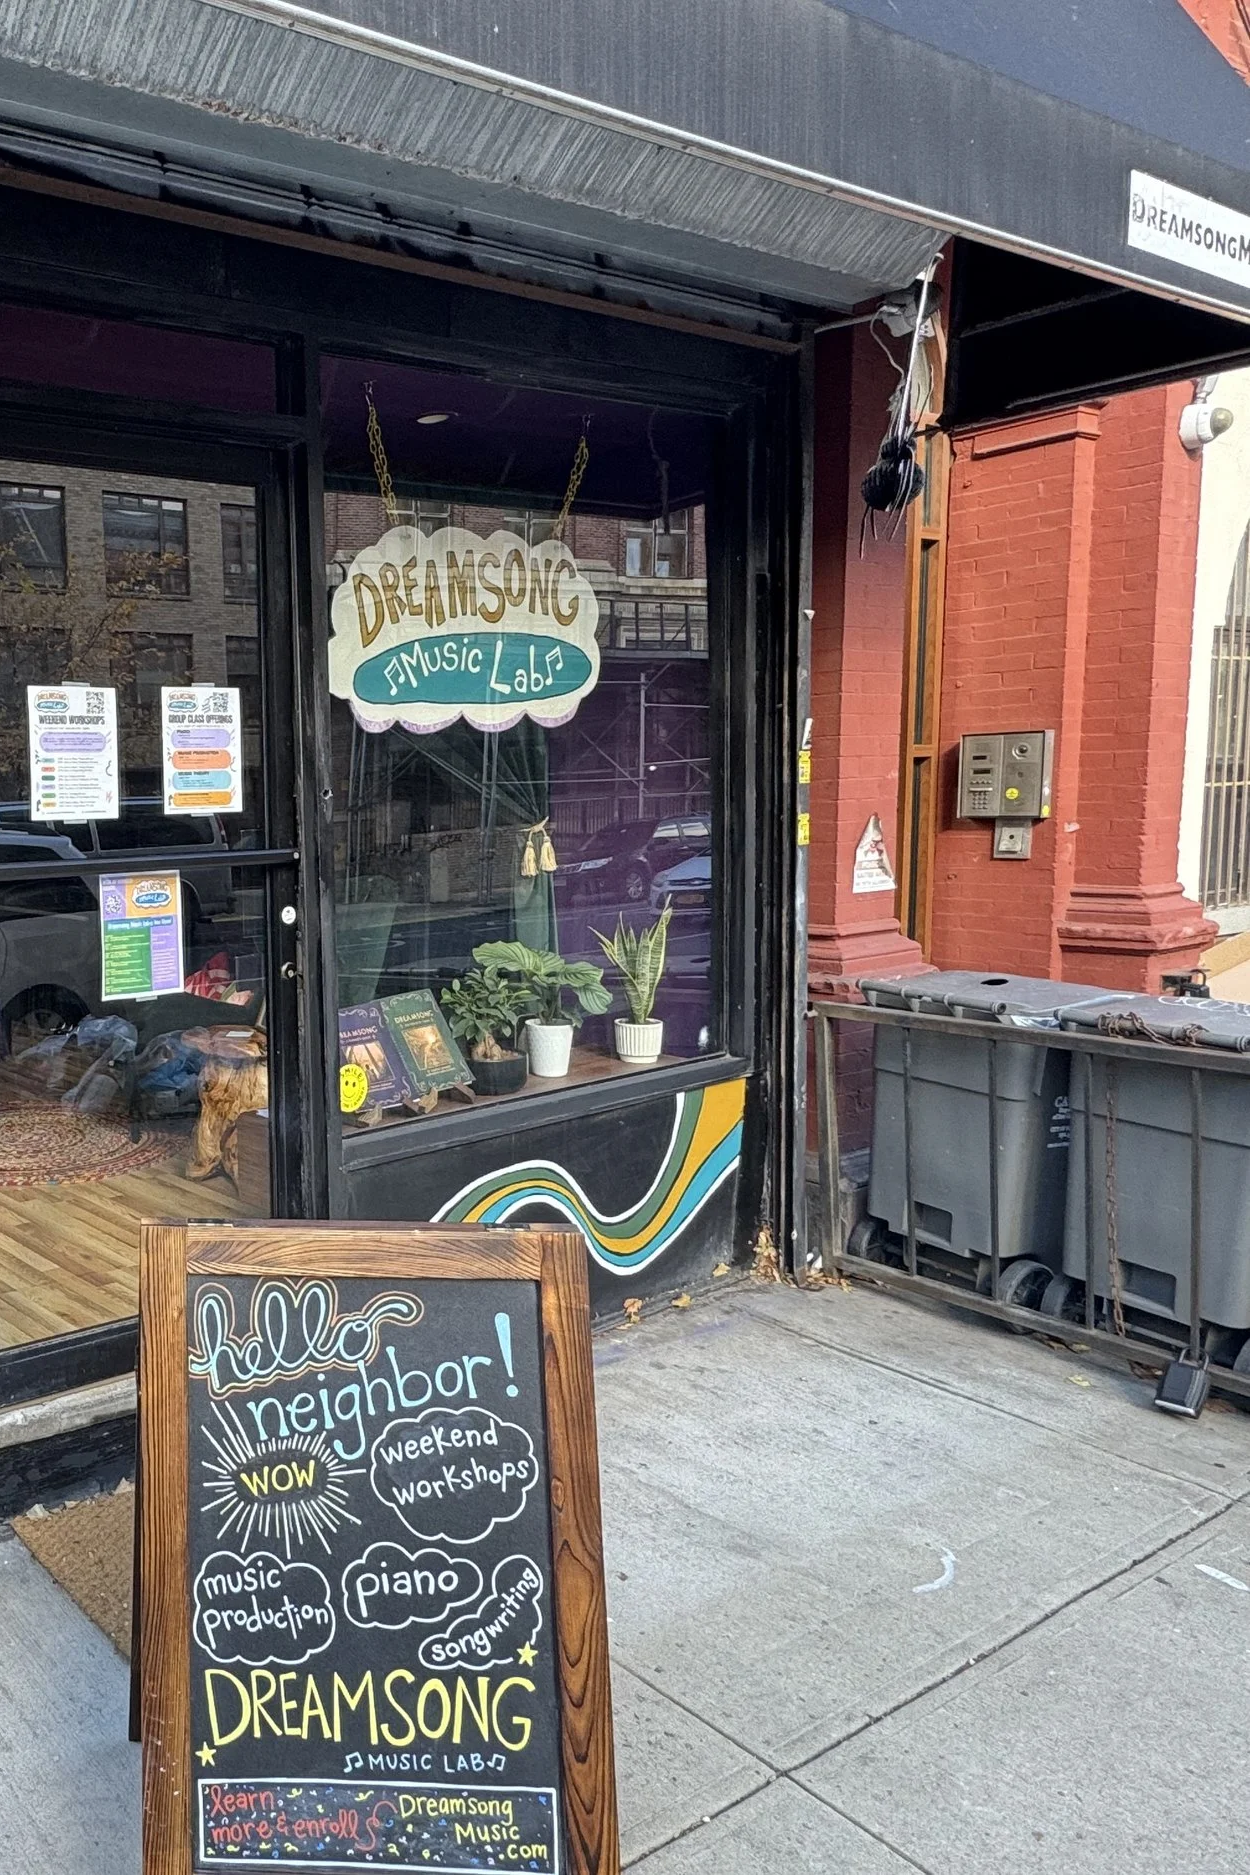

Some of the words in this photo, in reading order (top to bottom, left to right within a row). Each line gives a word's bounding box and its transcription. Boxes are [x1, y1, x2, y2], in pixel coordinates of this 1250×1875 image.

[352, 548, 580, 648] DREAMSONG
[400, 638, 483, 689] Music
[489, 640, 545, 695] Lab
[38, 715, 67, 725] WEEKEND
[69, 715, 105, 725] WORKSHOPS
[168, 714, 187, 724] GROUP
[188, 714, 205, 724] CLASS
[206, 715, 233, 724] OFFERINGS
[190, 1280, 412, 1389] hello
[247, 1312, 520, 1460] neighbor!
[379, 1418, 499, 1465] weekend
[240, 1459, 316, 1497] WOW
[392, 1458, 529, 1505] workshops
[202, 1561, 282, 1599] music
[356, 1562, 459, 1617] piano
[203, 1595, 329, 1649] production
[431, 1567, 540, 1663] songwriting
[204, 1669, 537, 1752] DREAMSONG
[368, 1753, 432, 1772] MUSIC
[444, 1753, 486, 1773] LAB
[209, 1785, 275, 1818] learn
[399, 1793, 513, 1826] Dreamsong
[211, 1817, 274, 1844] more
[292, 1808, 359, 1841] enroll
[455, 1820, 520, 1844] Music
[498, 1842, 548, 1861] .com
